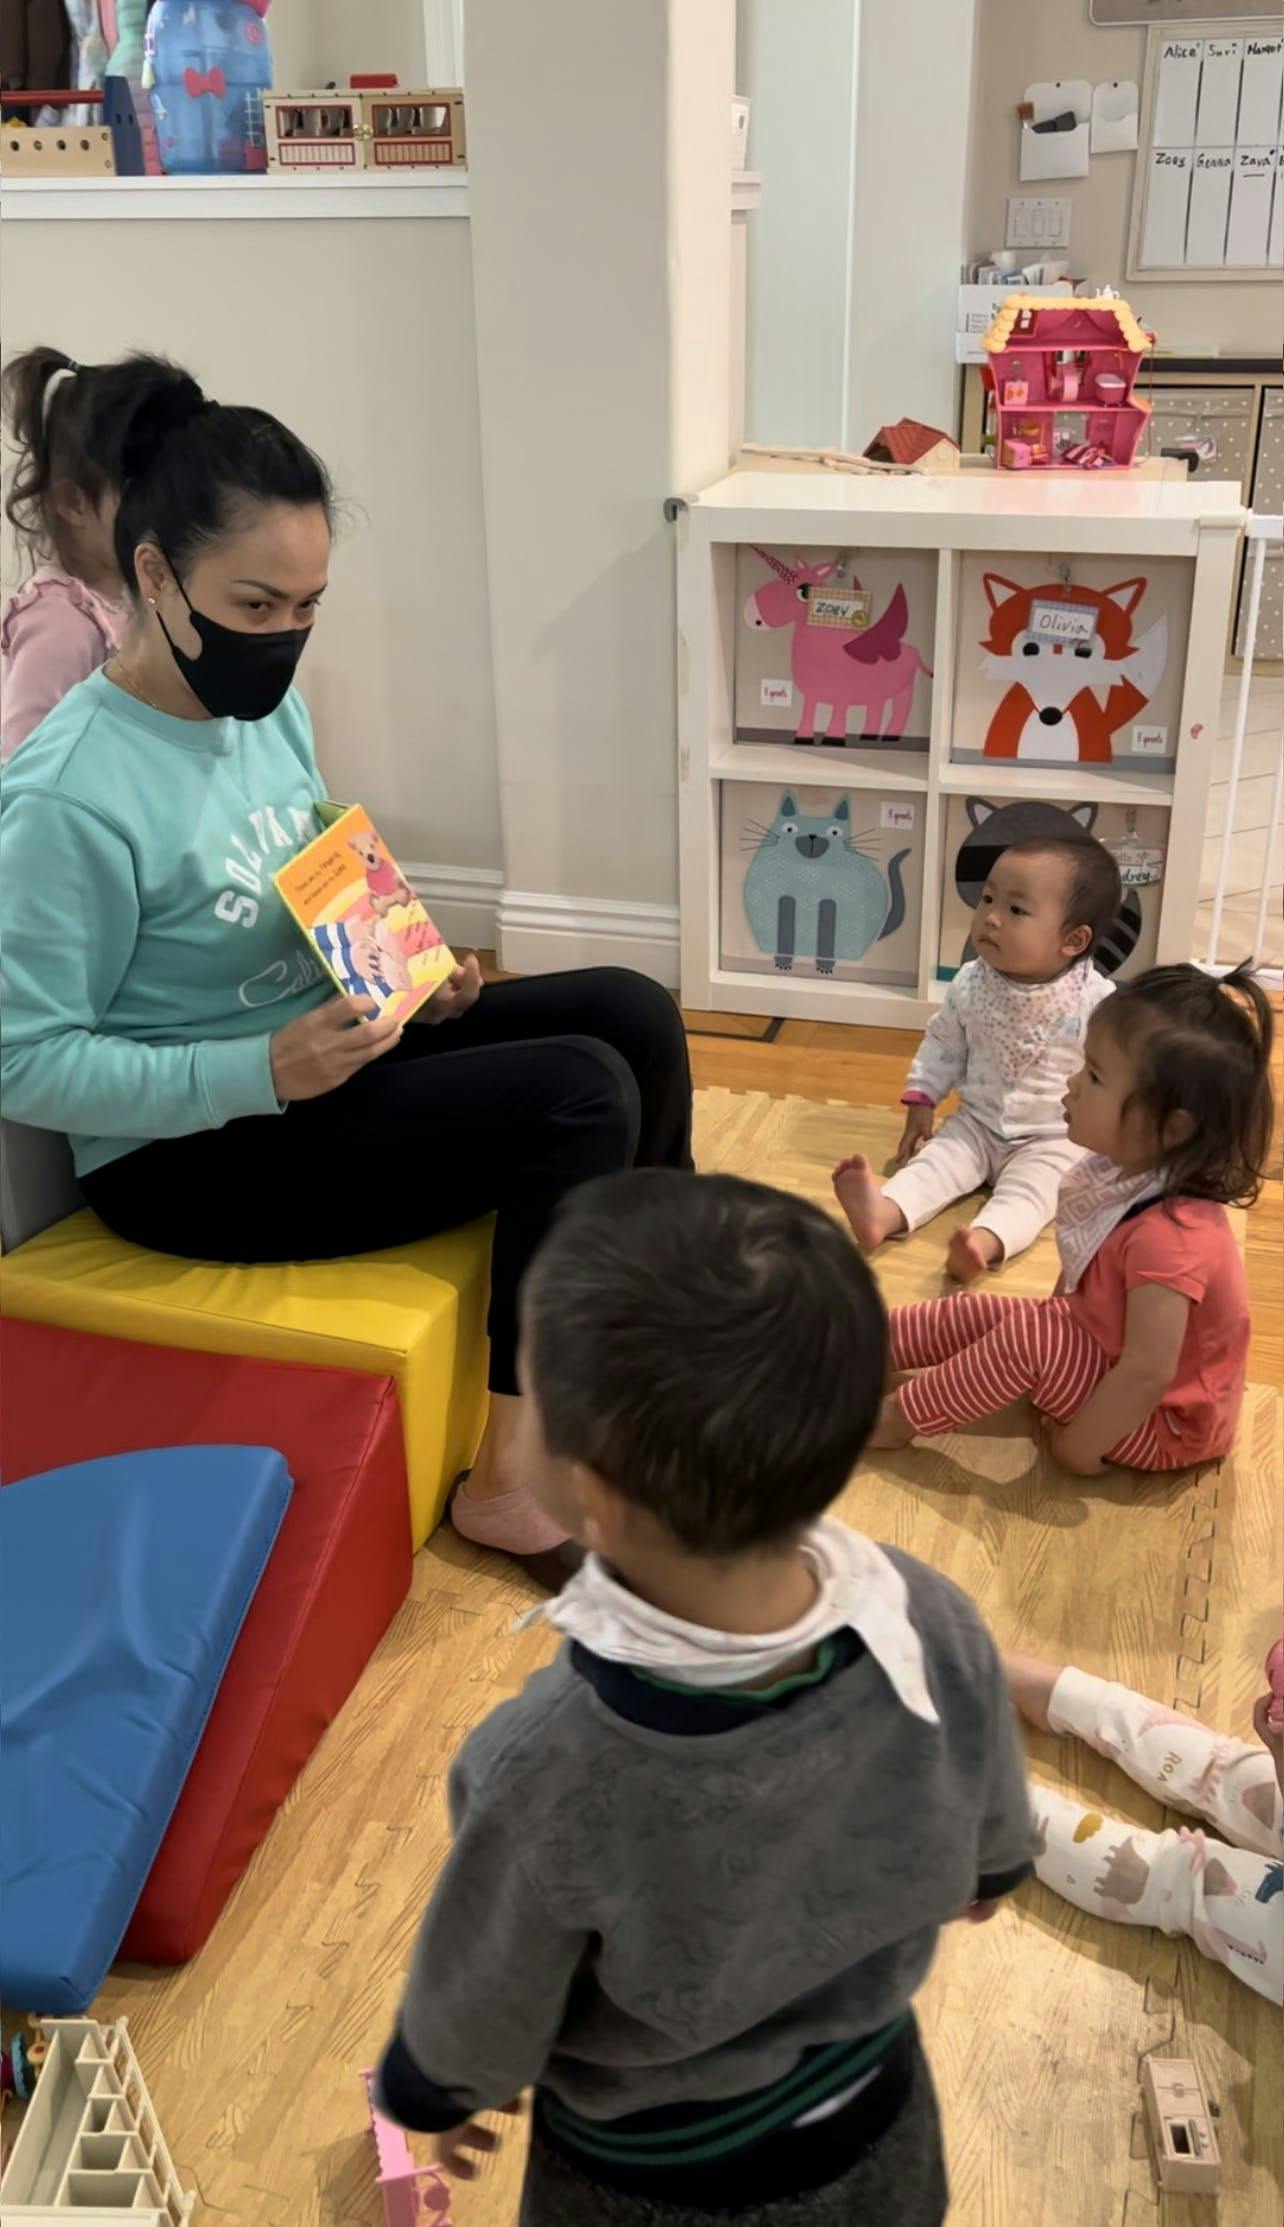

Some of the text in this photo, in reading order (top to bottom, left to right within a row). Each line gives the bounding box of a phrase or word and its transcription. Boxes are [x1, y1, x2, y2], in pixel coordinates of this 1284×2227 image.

[1164, 44, 1197, 59] Alice
[1040, 613, 1089, 634] Olivia
[214, 805, 318, 929] SOLVAN
